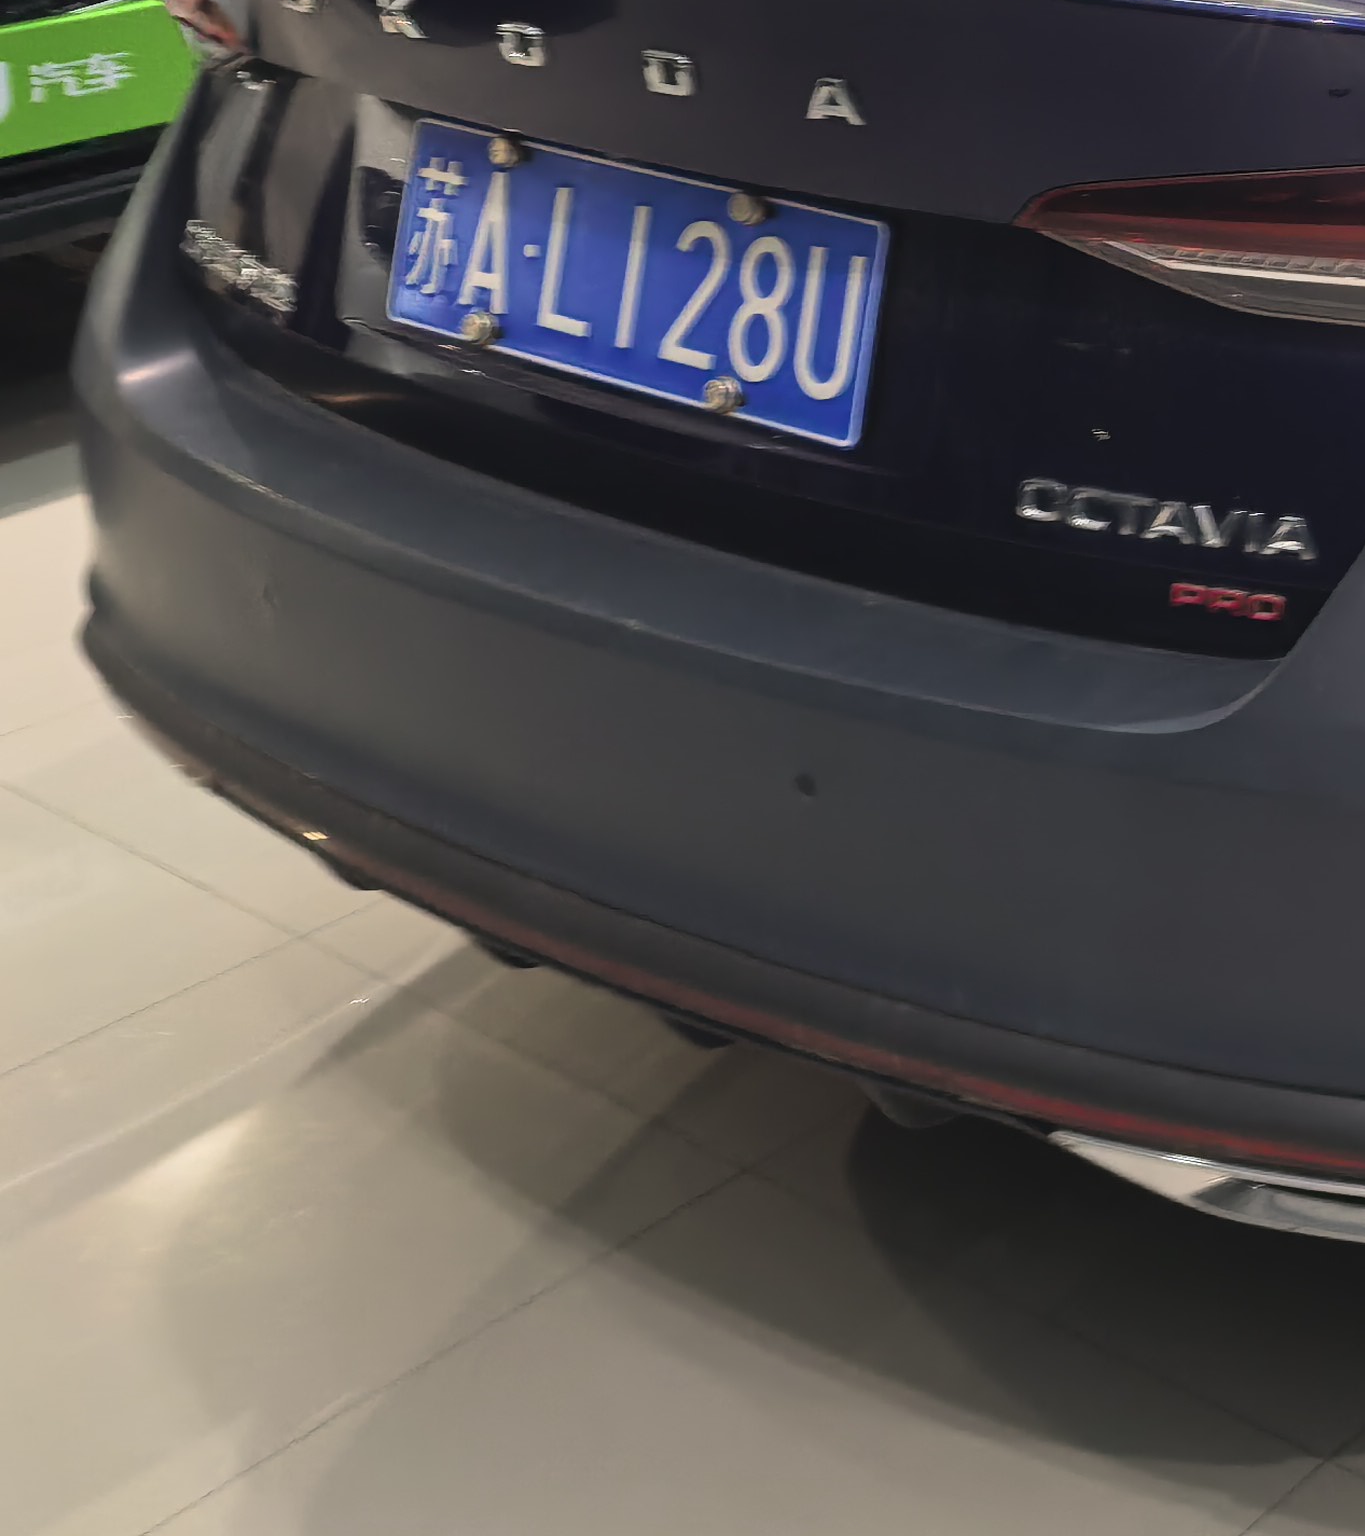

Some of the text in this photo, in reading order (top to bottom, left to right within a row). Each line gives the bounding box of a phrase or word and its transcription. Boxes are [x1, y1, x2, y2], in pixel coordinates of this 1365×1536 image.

[27, 51, 137, 104] 汽车
[1015, 476, 1319, 563] OCTAVIA
[1168, 580, 1288, 624] PRO
